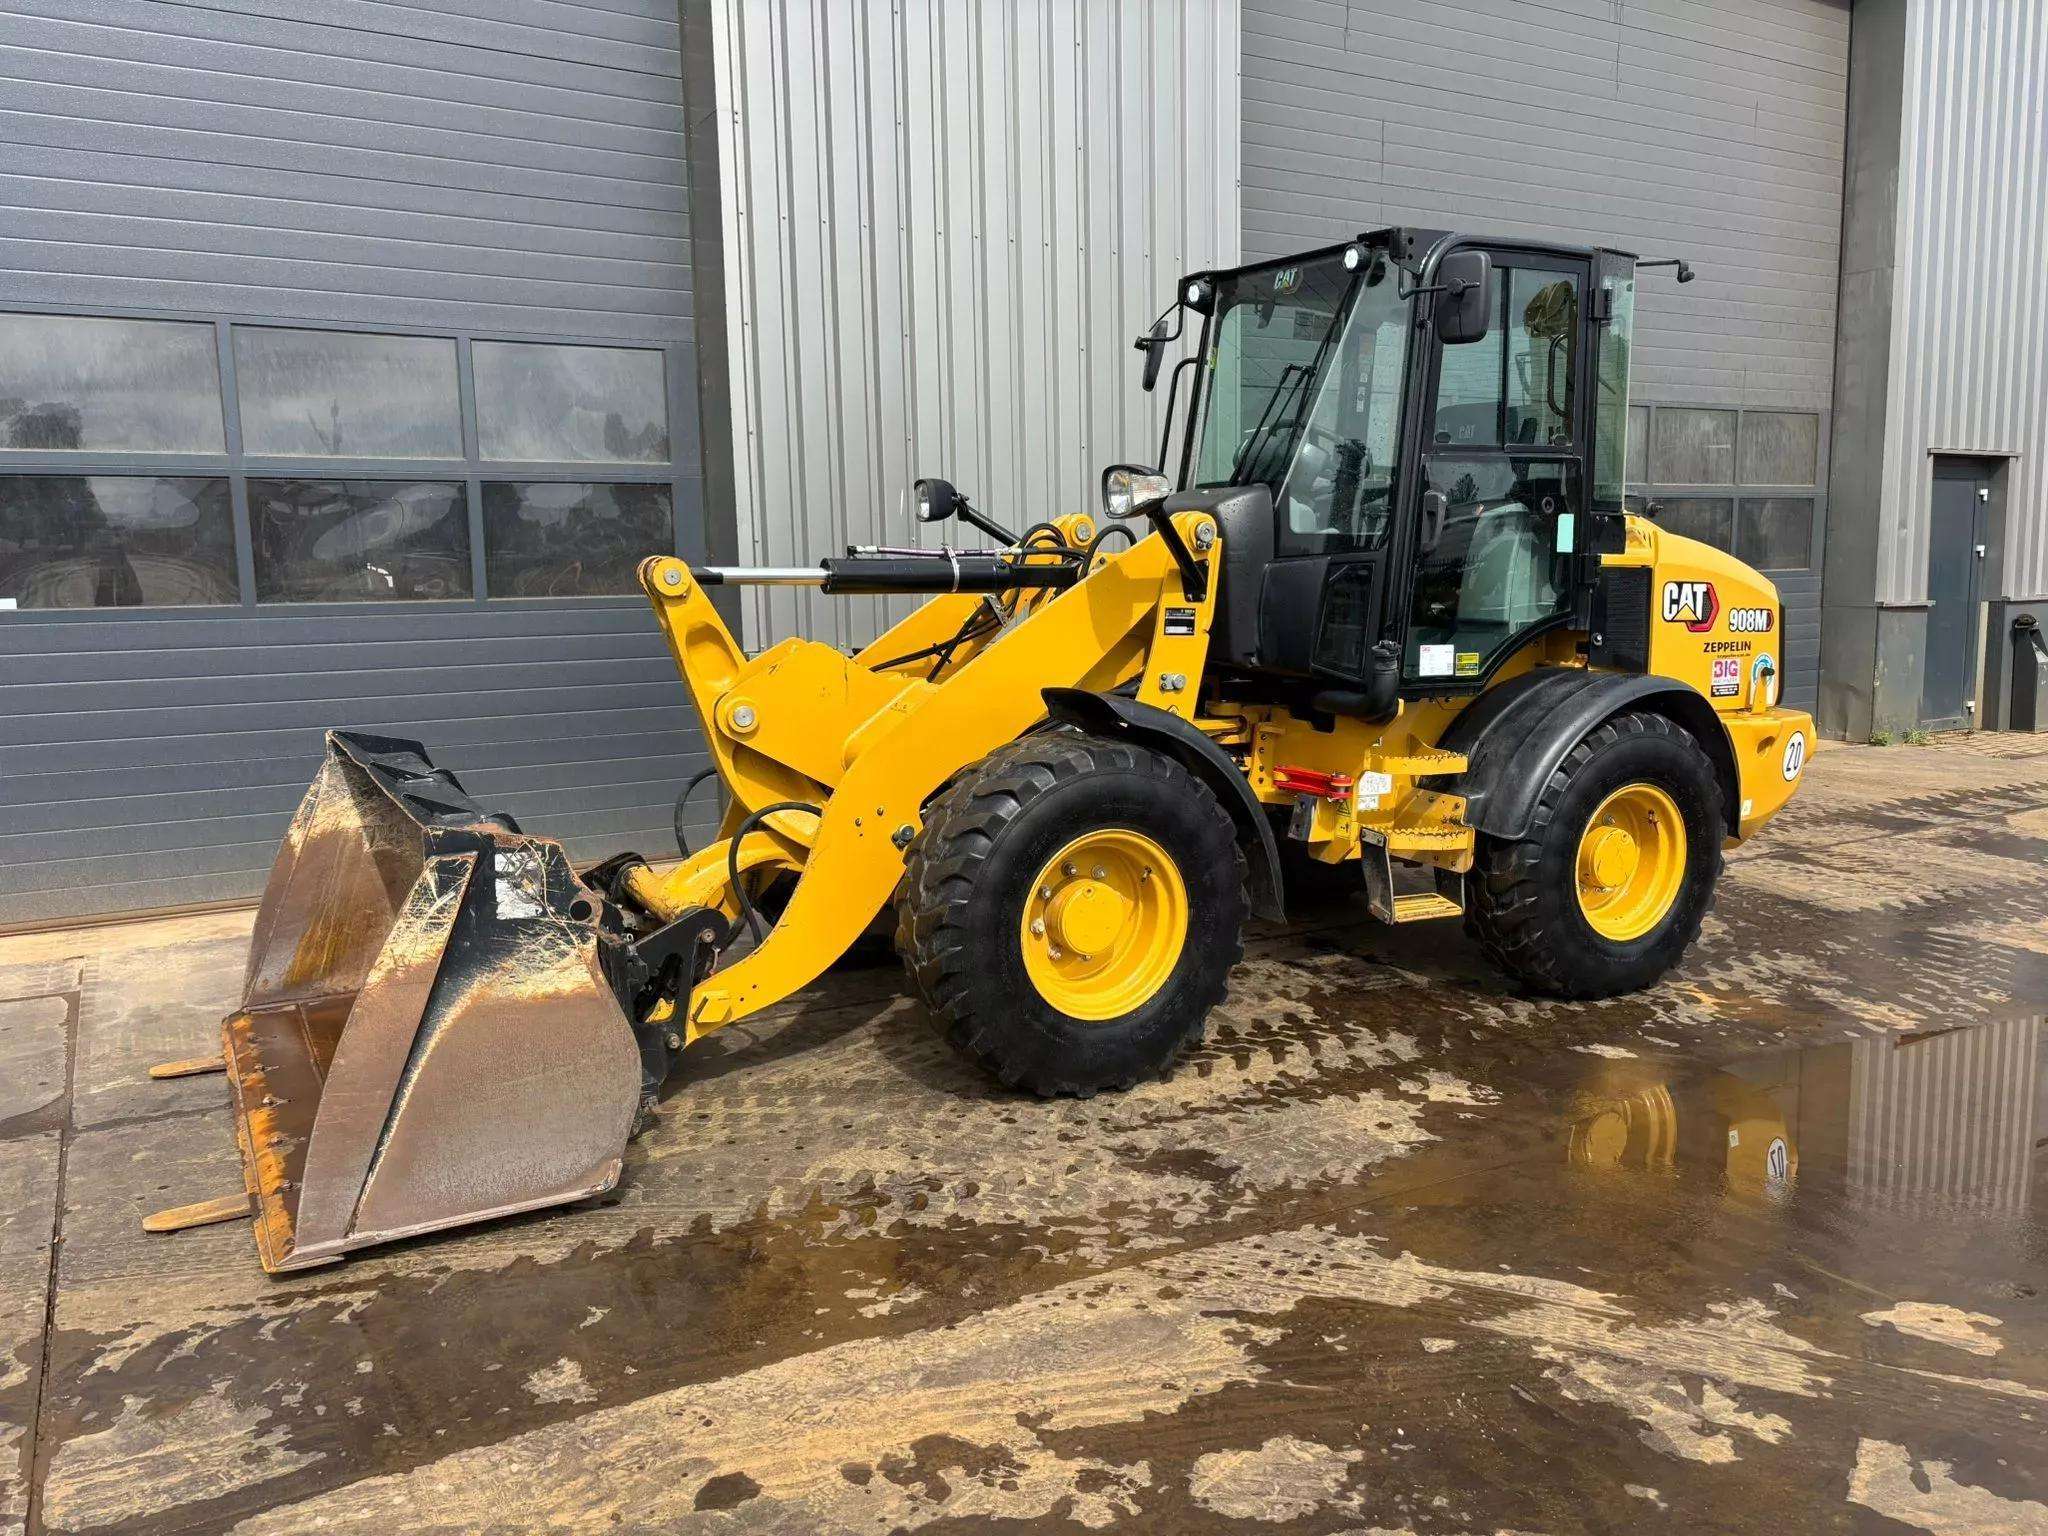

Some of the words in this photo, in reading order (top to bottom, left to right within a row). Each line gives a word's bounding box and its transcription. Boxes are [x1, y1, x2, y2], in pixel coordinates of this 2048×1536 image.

[1273, 266, 1298, 290] CAT
[1663, 582, 1707, 622] CAT
[1729, 608, 1768, 633] 908M
[1703, 641, 1751, 653] ZEPPELIN
[1785, 742, 1803, 772] 20
